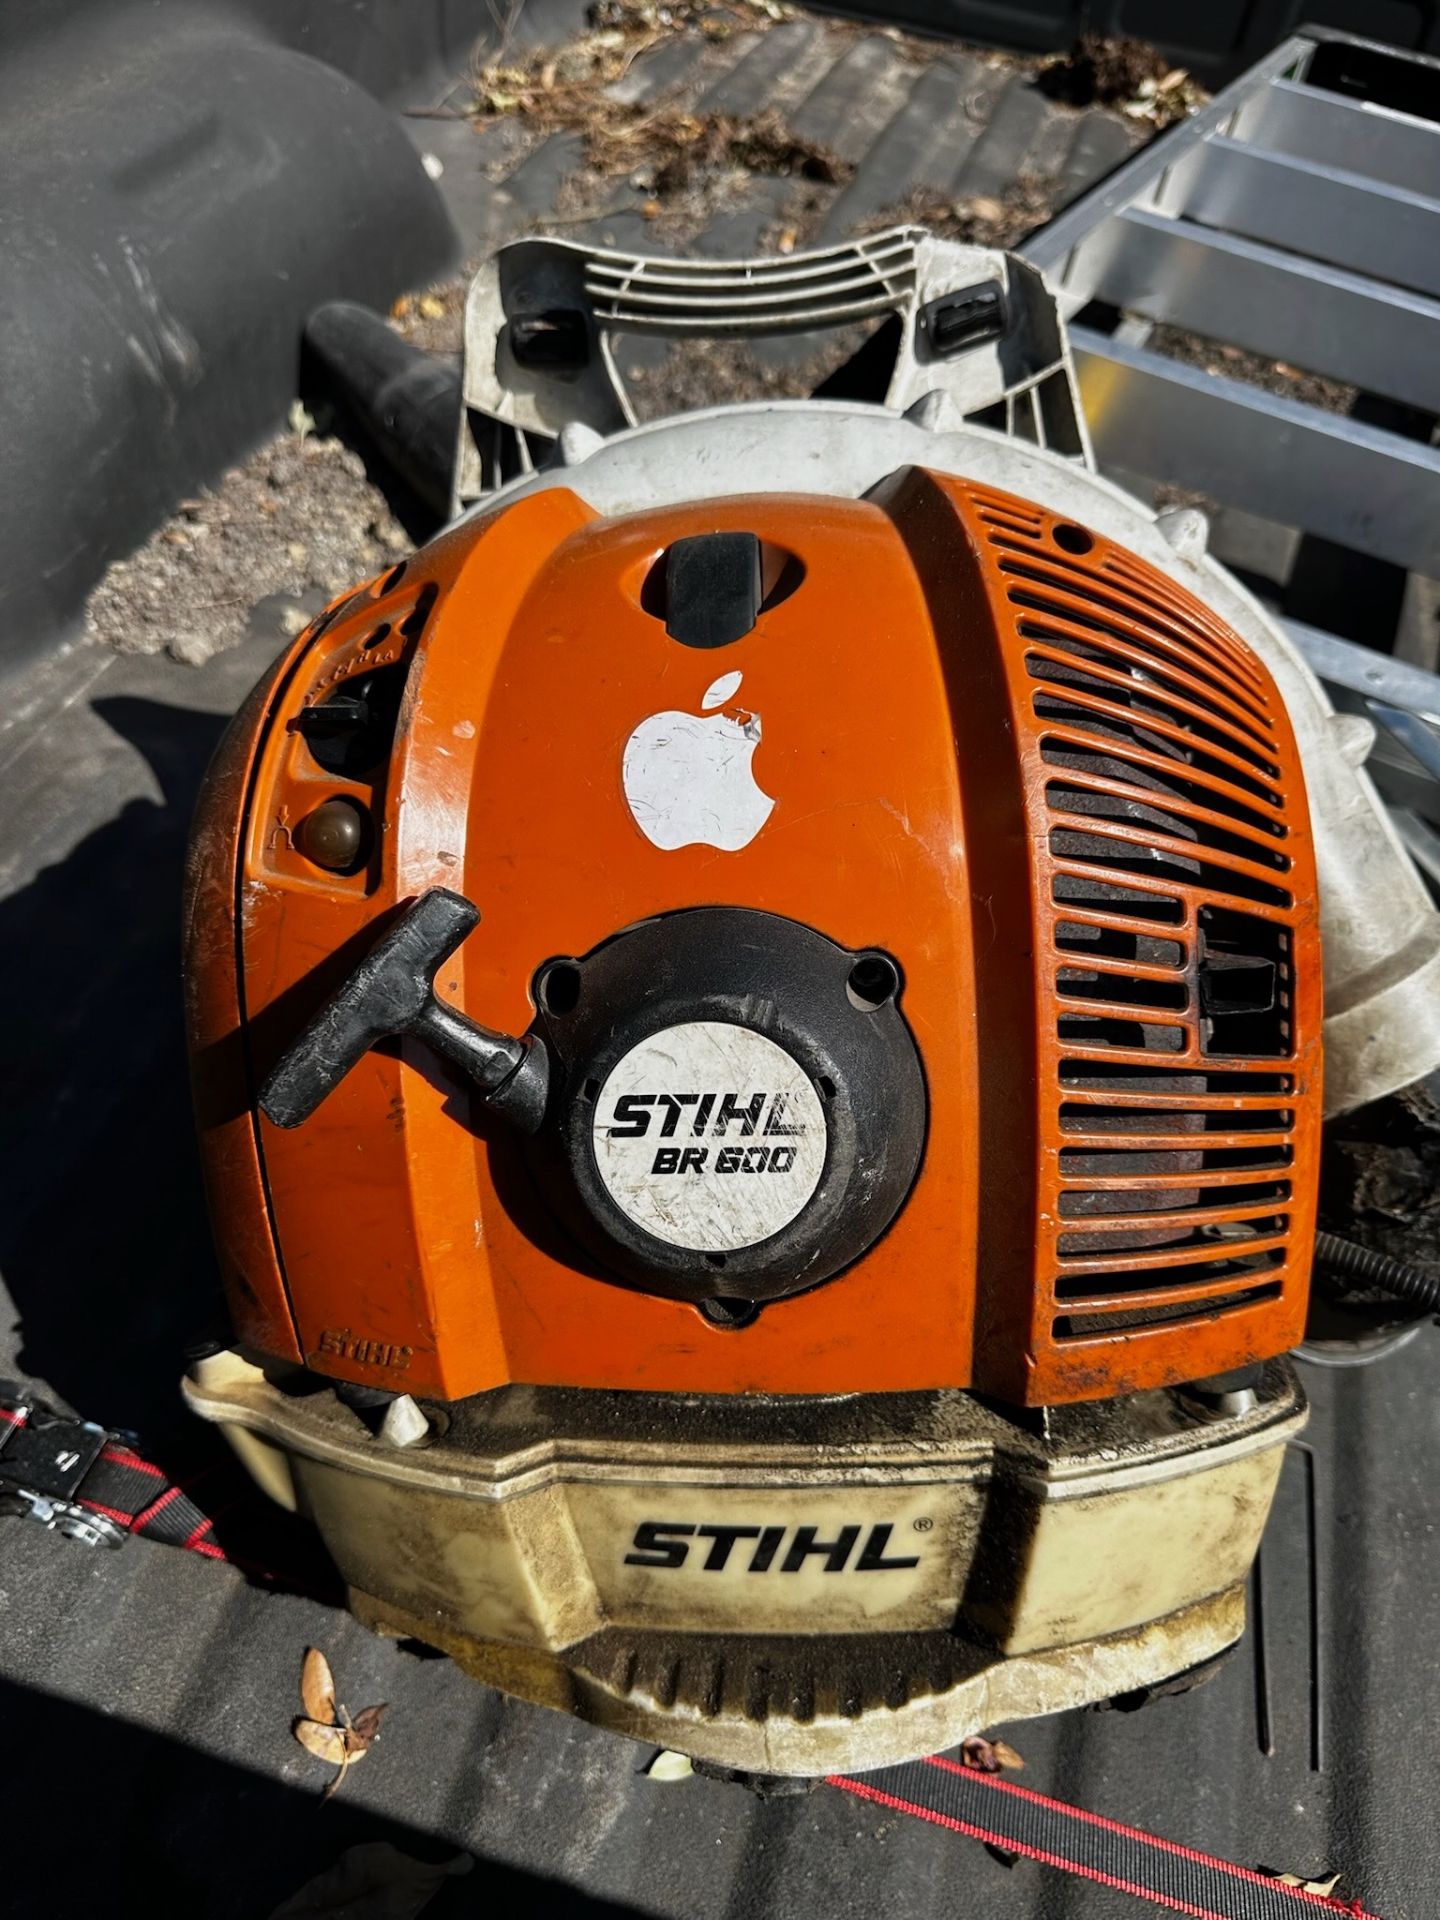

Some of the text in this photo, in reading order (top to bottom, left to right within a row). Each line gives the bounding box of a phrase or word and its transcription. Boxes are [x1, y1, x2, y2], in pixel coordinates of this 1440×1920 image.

[606, 1092, 805, 1138] STIHL
[651, 1146, 797, 1175] BR 600
